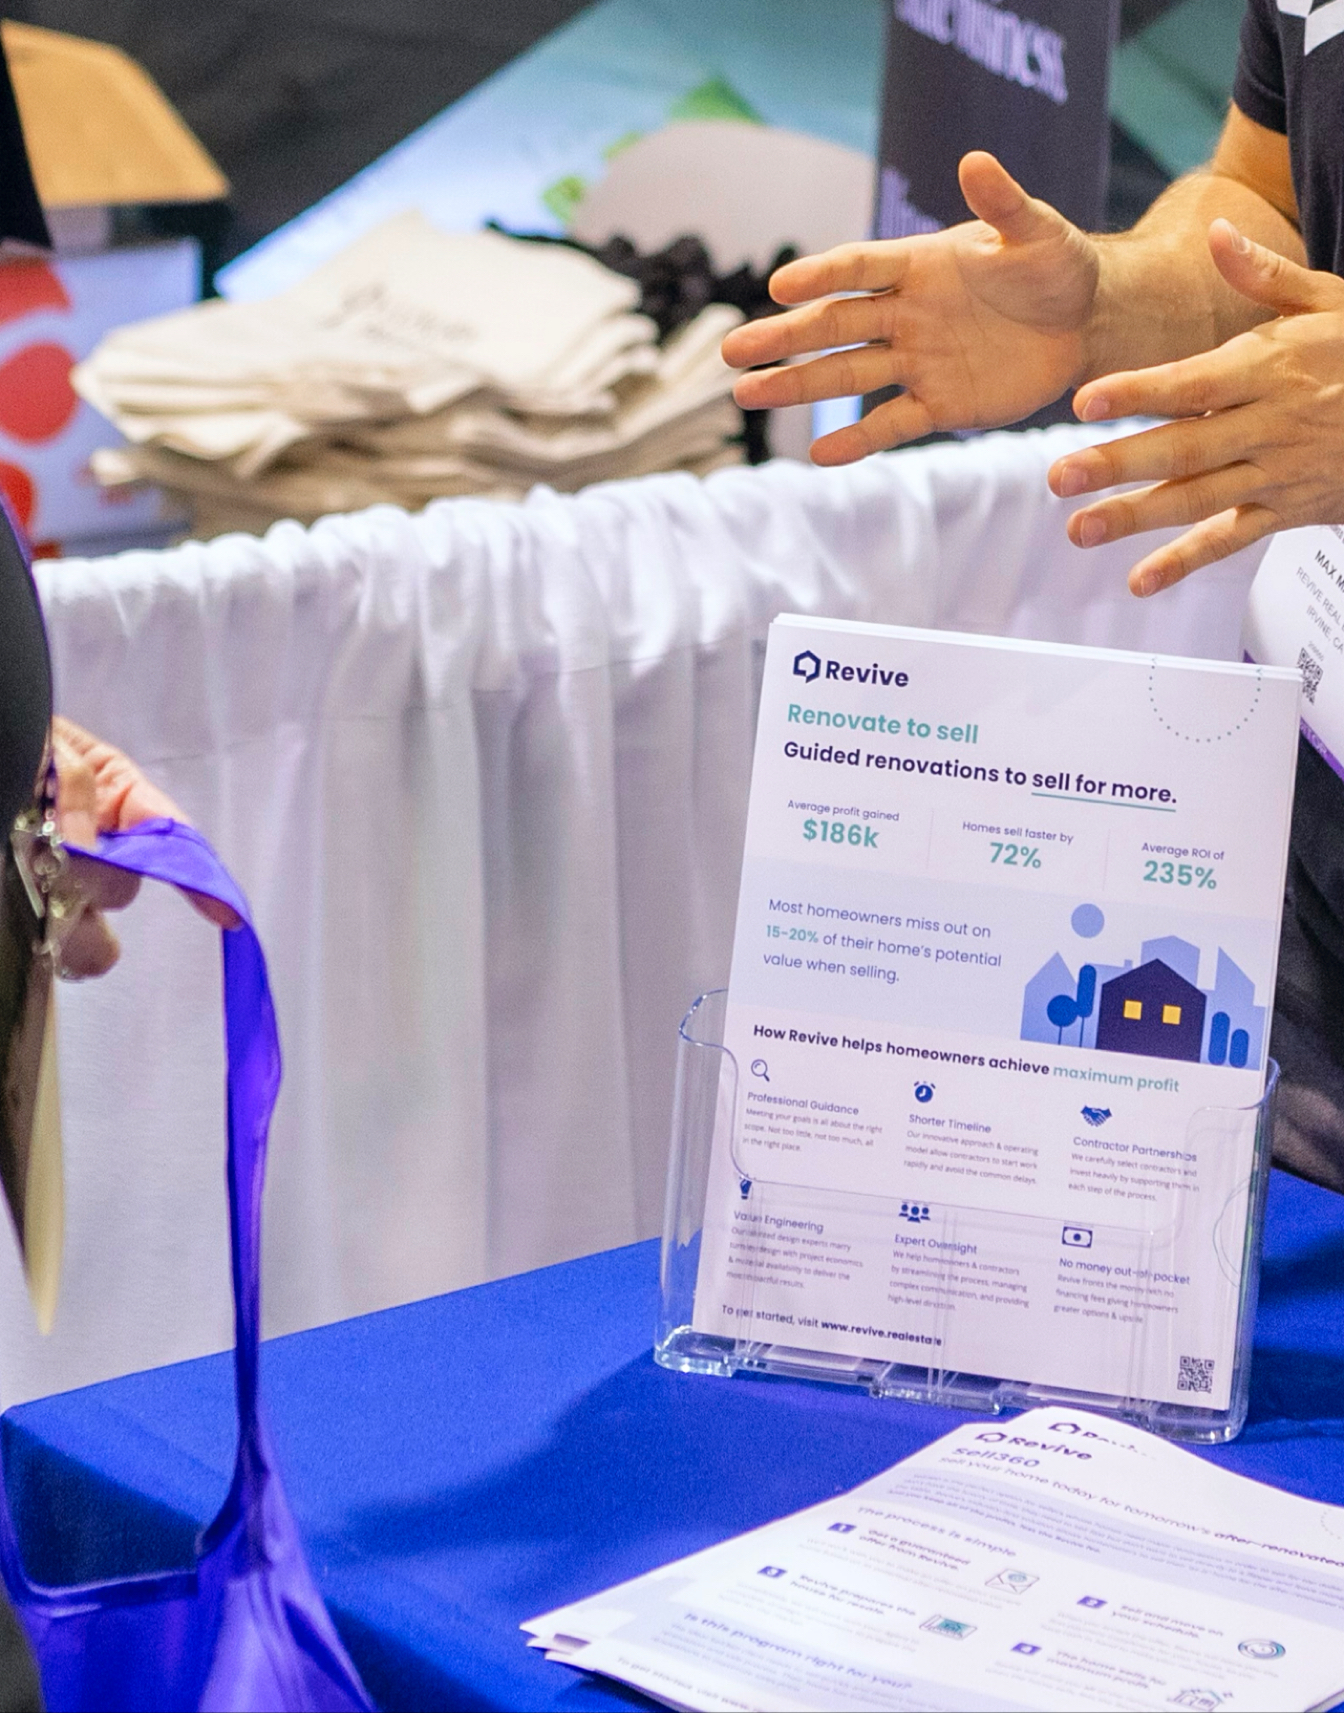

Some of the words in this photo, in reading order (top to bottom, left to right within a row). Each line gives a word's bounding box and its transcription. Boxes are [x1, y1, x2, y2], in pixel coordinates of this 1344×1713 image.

[1315, 550, 1337, 579] MAX
[1296, 566, 1322, 602] REVIVE
[1323, 598, 1341, 625] REAL
[1333, 636, 1344, 654] CA
[825, 660, 908, 687] Revive
[787, 703, 901, 734] Renovate
[906, 718, 930, 738] to
[936, 723, 978, 743] sell
[784, 741, 860, 765] Guided
[865, 753, 998, 781] renovations
[1005, 767, 1026, 785] to
[1032, 772, 1070, 790] sell
[1075, 773, 1106, 794] for
[1111, 782, 1176, 803] more.
[787, 799, 830, 814] Average
[832, 806, 859, 816] profit
[862, 810, 899, 821] gained
[802, 818, 879, 848] $186k
[962, 821, 1001, 834] Homes
[1004, 827, 1022, 836] sell
[1025, 828, 1056, 840] faster
[1059, 832, 1073, 844] by
[990, 841, 1041, 868] 72%
[1141, 842, 1189, 858] Average
[1191, 847, 1211, 858] ROI
[1212, 850, 1224, 860] of
[1143, 859, 1216, 889] 235%
[768, 898, 803, 914] Most
[806, 902, 901, 926] homeowners
[905, 917, 939, 931] miss
[943, 922, 968, 935] out
[971, 926, 990, 937] on
[822, 933, 837, 945] of
[841, 935, 873, 949] their
[934, 949, 1001, 966] potential
[763, 953, 802, 968] value
[806, 959, 845, 974] when
[849, 965, 899, 984] selling.
[753, 1024, 786, 1039] How
[788, 1029, 838, 1046] Revive
[841, 1035, 882, 1054] helps
[886, 1041, 984, 1066] homeowners
[988, 1057, 1049, 1074] achieve
[1052, 1066, 1133, 1086] maximum
[1136, 1077, 1179, 1092] profit
[747, 1091, 808, 1108] Professional
[809, 1100, 859, 1115] Guidance
[909, 1113, 945, 1126] Shorter
[948, 1118, 991, 1133] Timeline
[1072, 1136, 1129, 1152] Contractor
[764, 1214, 823, 1235] Engineering
[894, 1233, 925, 1246] Expert
[1059, 1257, 1073, 1268] No
[1075, 1261, 1111, 1275] money
[797, 1316, 818, 1327] visit
[1007, 1437, 1092, 1461] Revive
[1052, 1481, 1098, 1501] today
